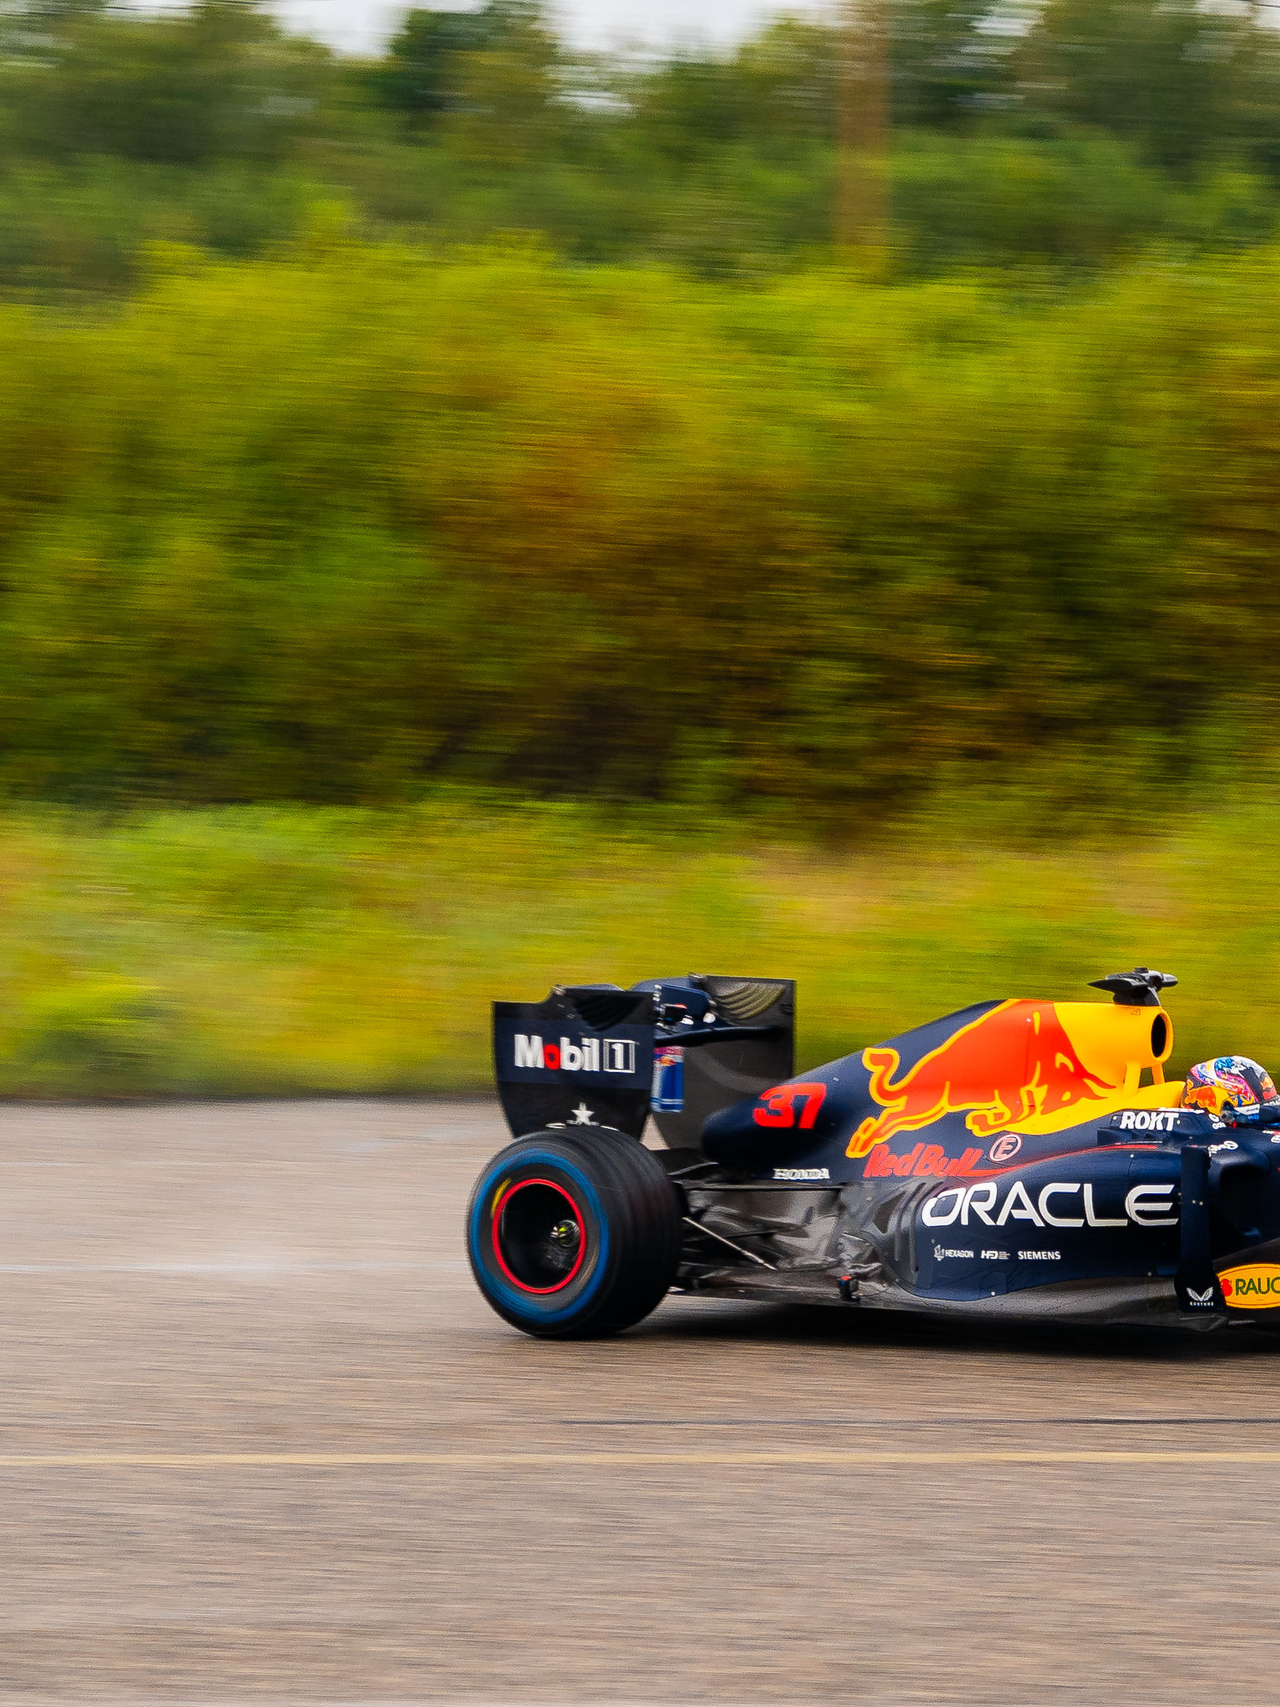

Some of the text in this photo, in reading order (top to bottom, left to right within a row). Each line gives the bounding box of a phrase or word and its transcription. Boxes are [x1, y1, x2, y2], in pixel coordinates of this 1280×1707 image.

[514, 1034, 600, 1072] Mobil
[753, 1083, 826, 1129] 37
[1120, 1111, 1178, 1131] ROKT
[863, 1143, 984, 1178] Red Bull
[922, 1182, 1179, 1227] ORACLE
[1017, 1250, 1062, 1260] SIEMENS
